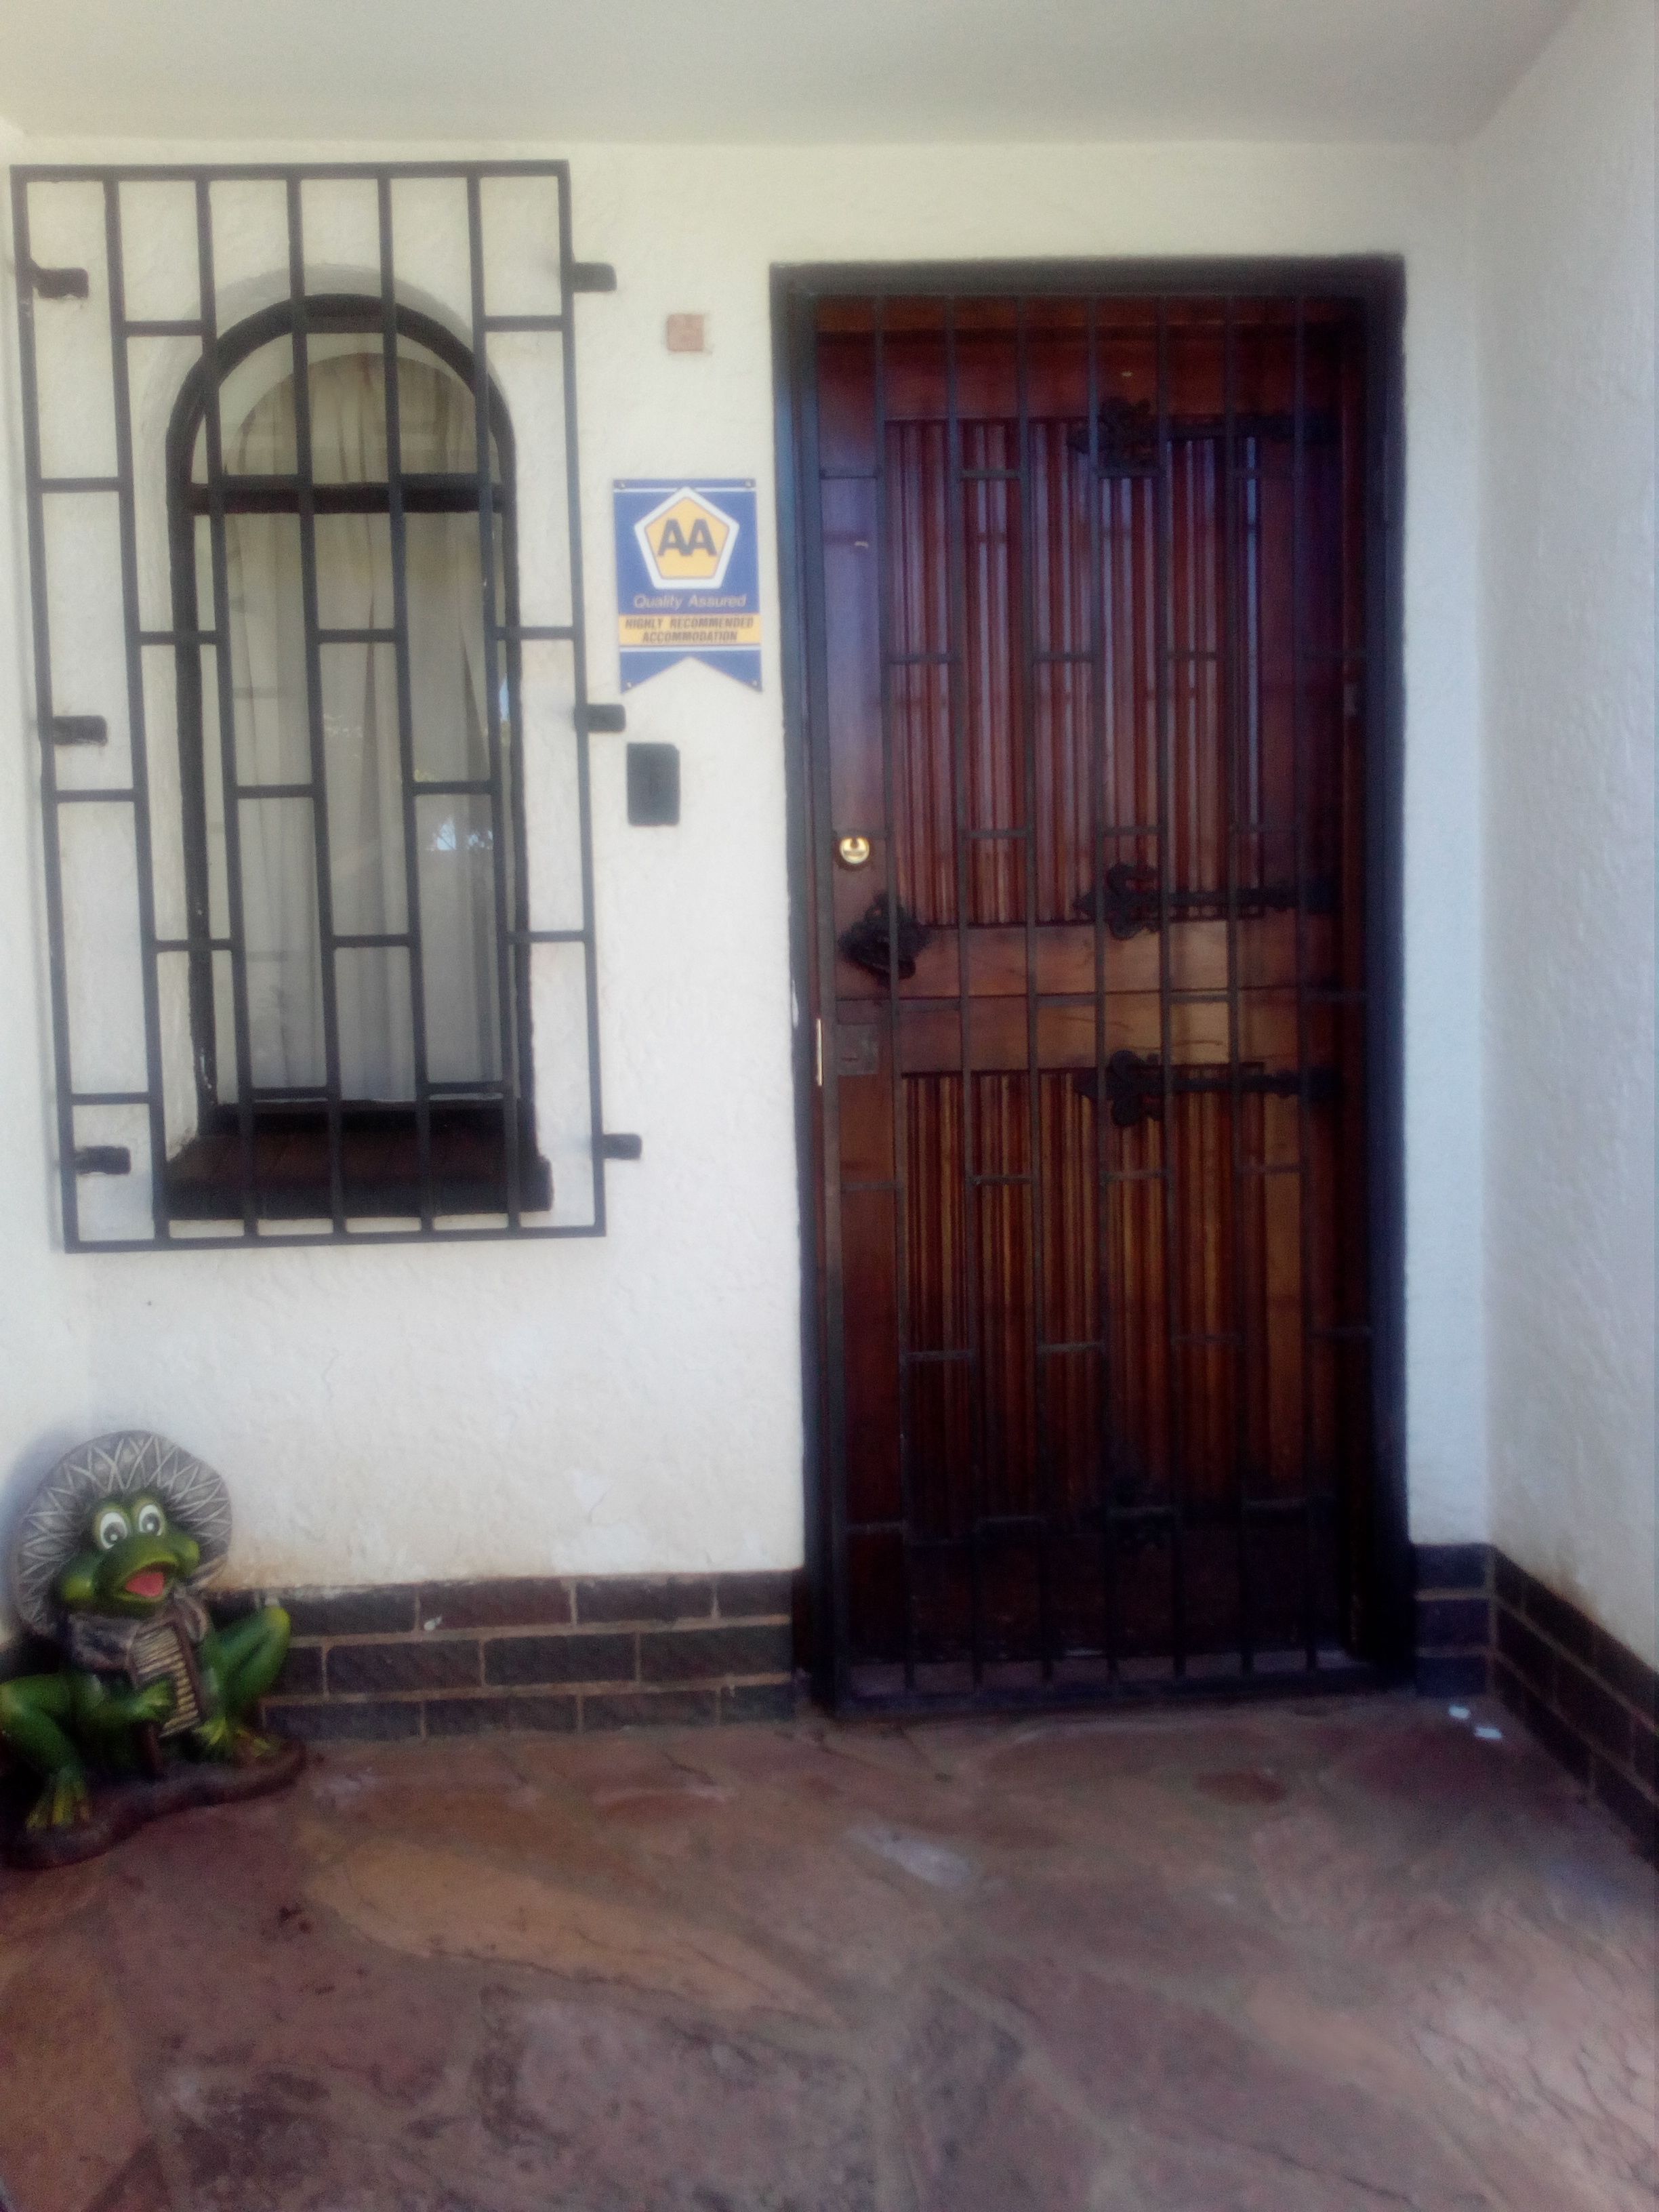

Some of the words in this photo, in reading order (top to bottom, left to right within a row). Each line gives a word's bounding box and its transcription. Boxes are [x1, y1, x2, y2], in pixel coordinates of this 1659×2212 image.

[657, 518, 717, 556] AA
[634, 594, 681, 609] Quality
[689, 594, 746, 607] Assured
[626, 618, 663, 629] HIGHLY
[670, 617, 754, 628] RECOMMENDED
[642, 630, 737, 642] ACCOMMODATION
